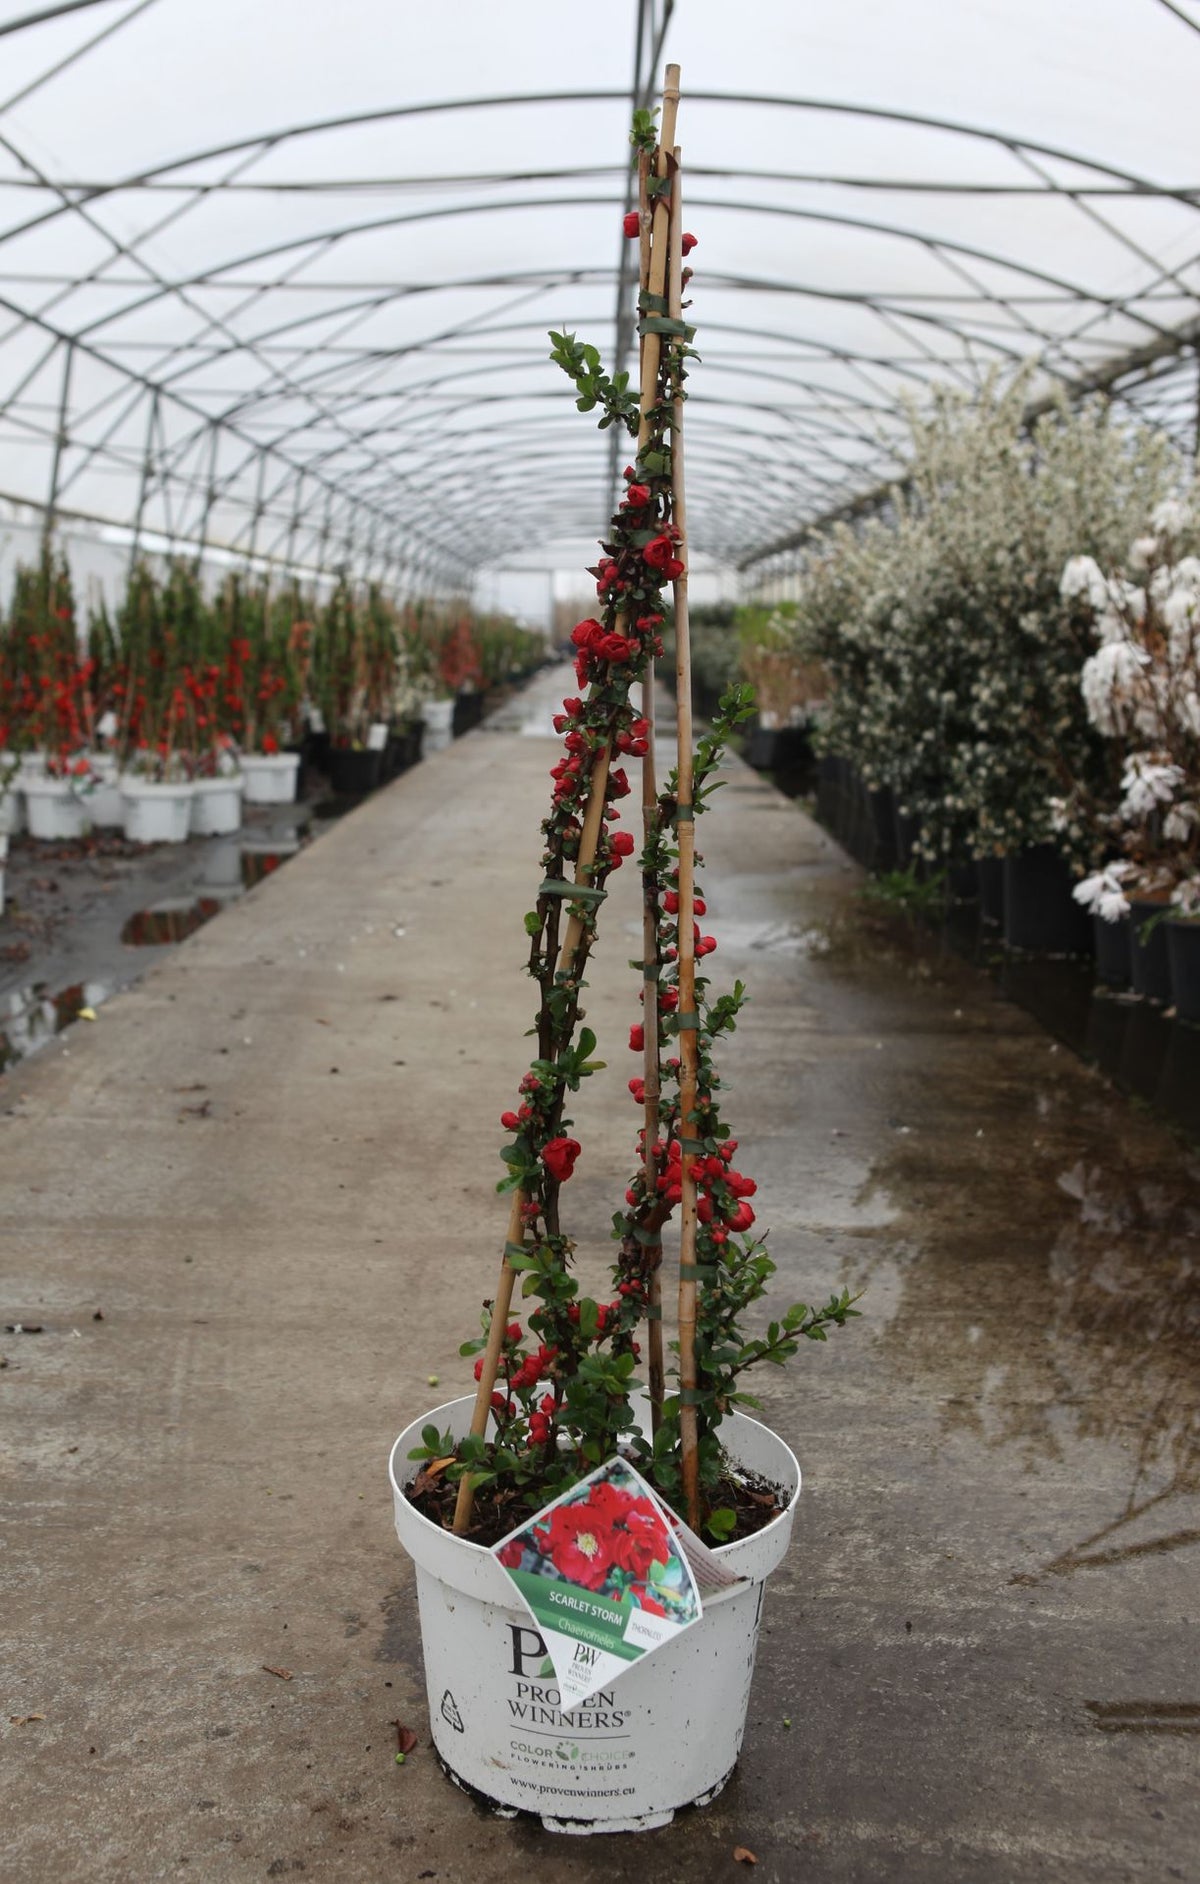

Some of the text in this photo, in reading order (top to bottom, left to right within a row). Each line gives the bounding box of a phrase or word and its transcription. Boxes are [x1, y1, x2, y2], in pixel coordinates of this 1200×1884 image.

[549, 1591, 624, 1627] SCARLET STORM
[558, 1617, 615, 1649] Chaenomeles
[516, 1682, 616, 1708] PROEN
[510, 1740, 553, 1759] COLOR
[510, 1753, 628, 1771] FLOWERING SHRUBS
[510, 1777, 636, 1798] www.provenwinners.eu
